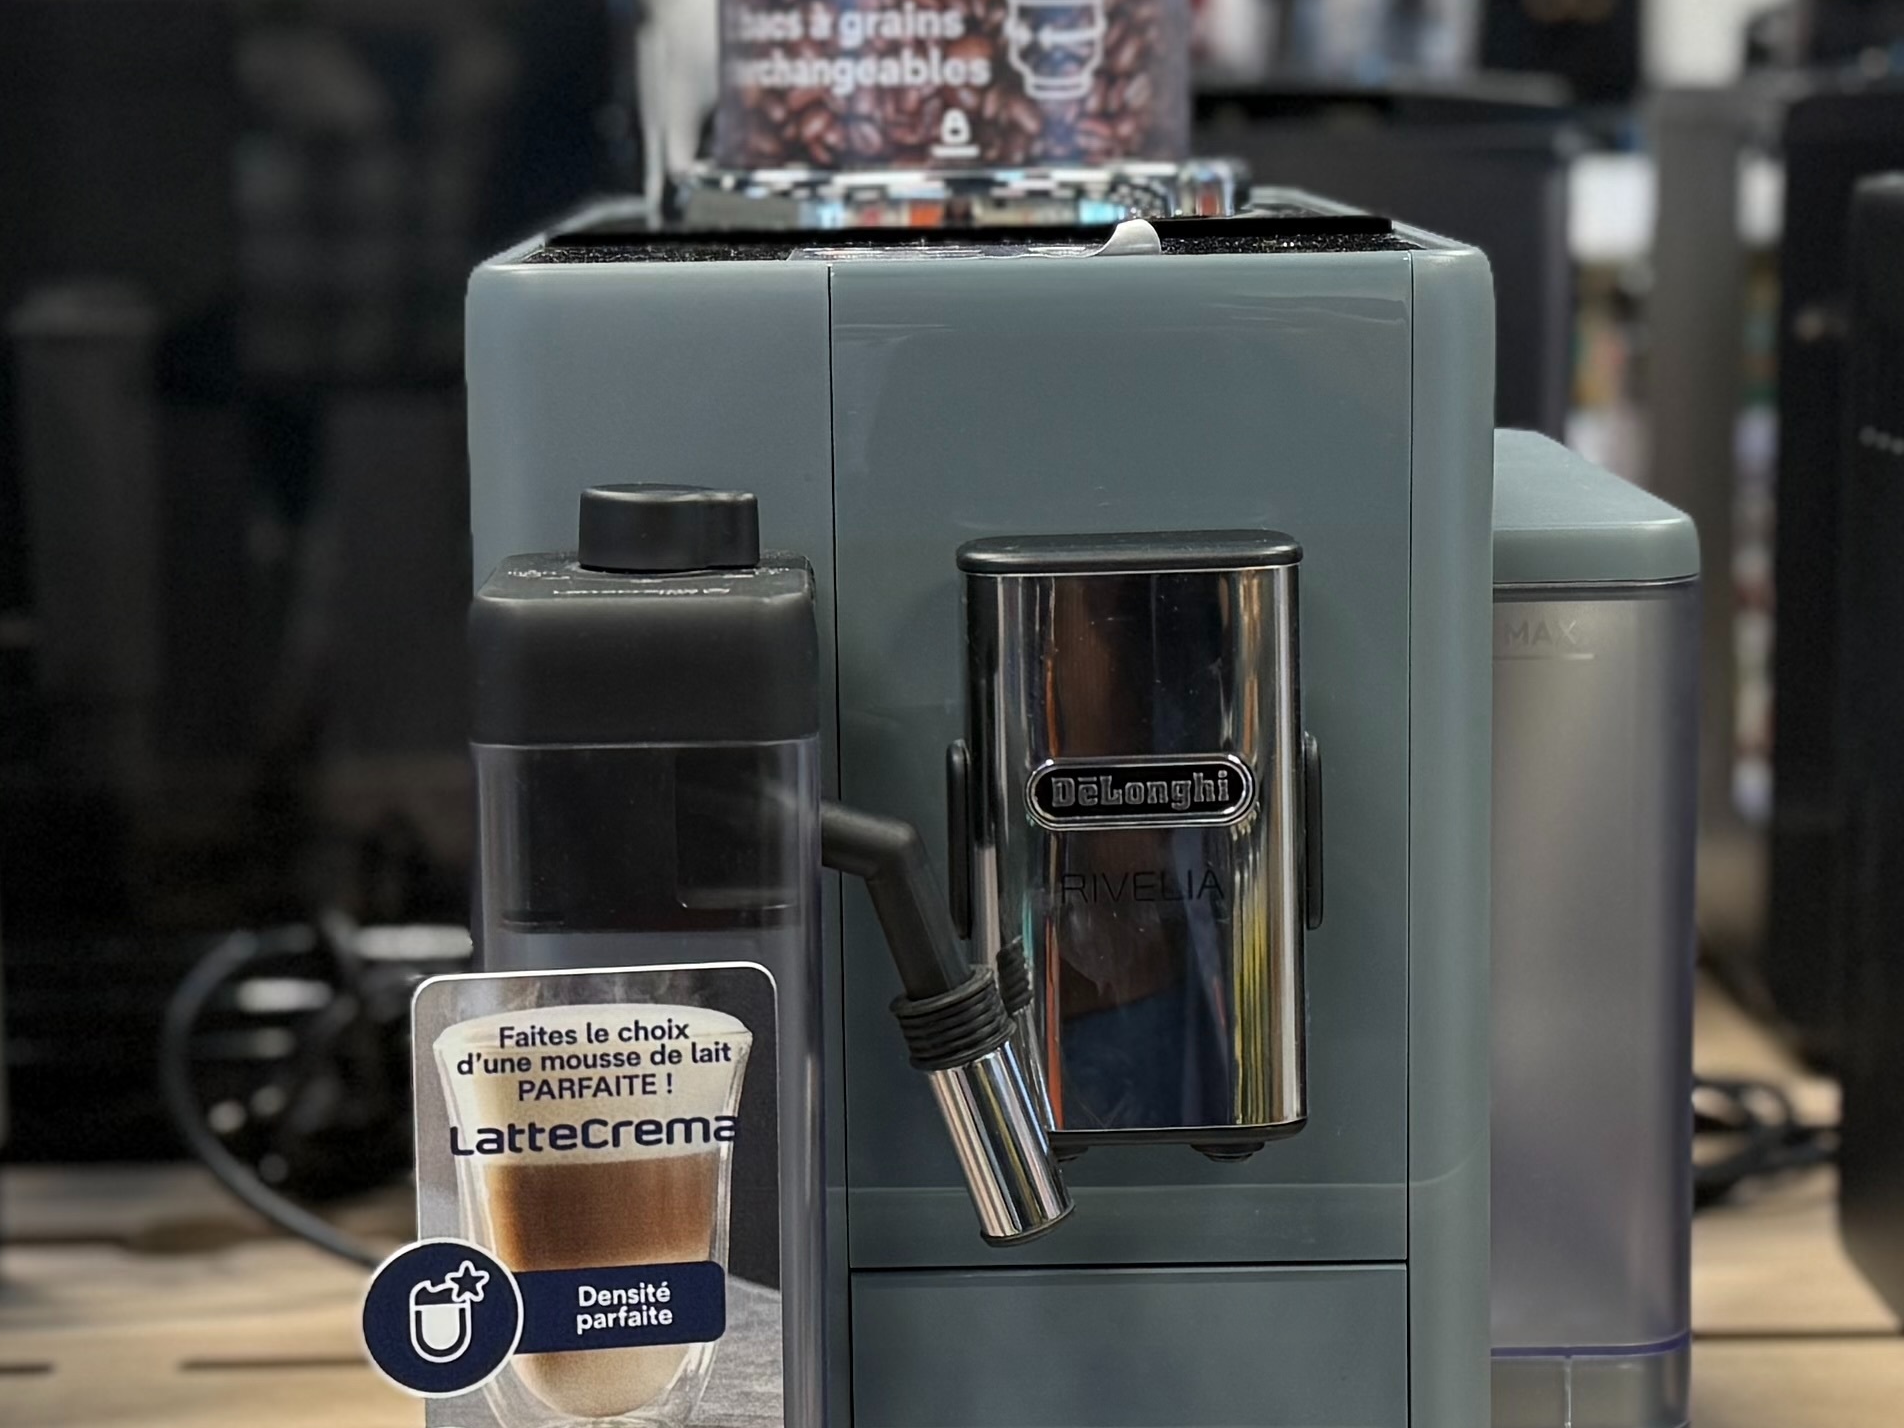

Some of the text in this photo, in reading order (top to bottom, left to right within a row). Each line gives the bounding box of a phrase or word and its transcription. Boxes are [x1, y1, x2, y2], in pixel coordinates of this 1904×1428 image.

[811, 6, 830, 38] à
[840, 4, 964, 46] grains
[1060, 871, 1225, 904] RIVELIA
[499, 1019, 690, 1048] Faites le choix
[541, 1050, 641, 1071] mousse
[650, 1045, 682, 1064] de
[691, 1042, 731, 1063] lait
[518, 1073, 672, 1101] PARFAITE !
[449, 1116, 740, 1156] LatteCrema
[578, 1283, 671, 1308] Densité
[576, 1306, 673, 1334] parfaite
